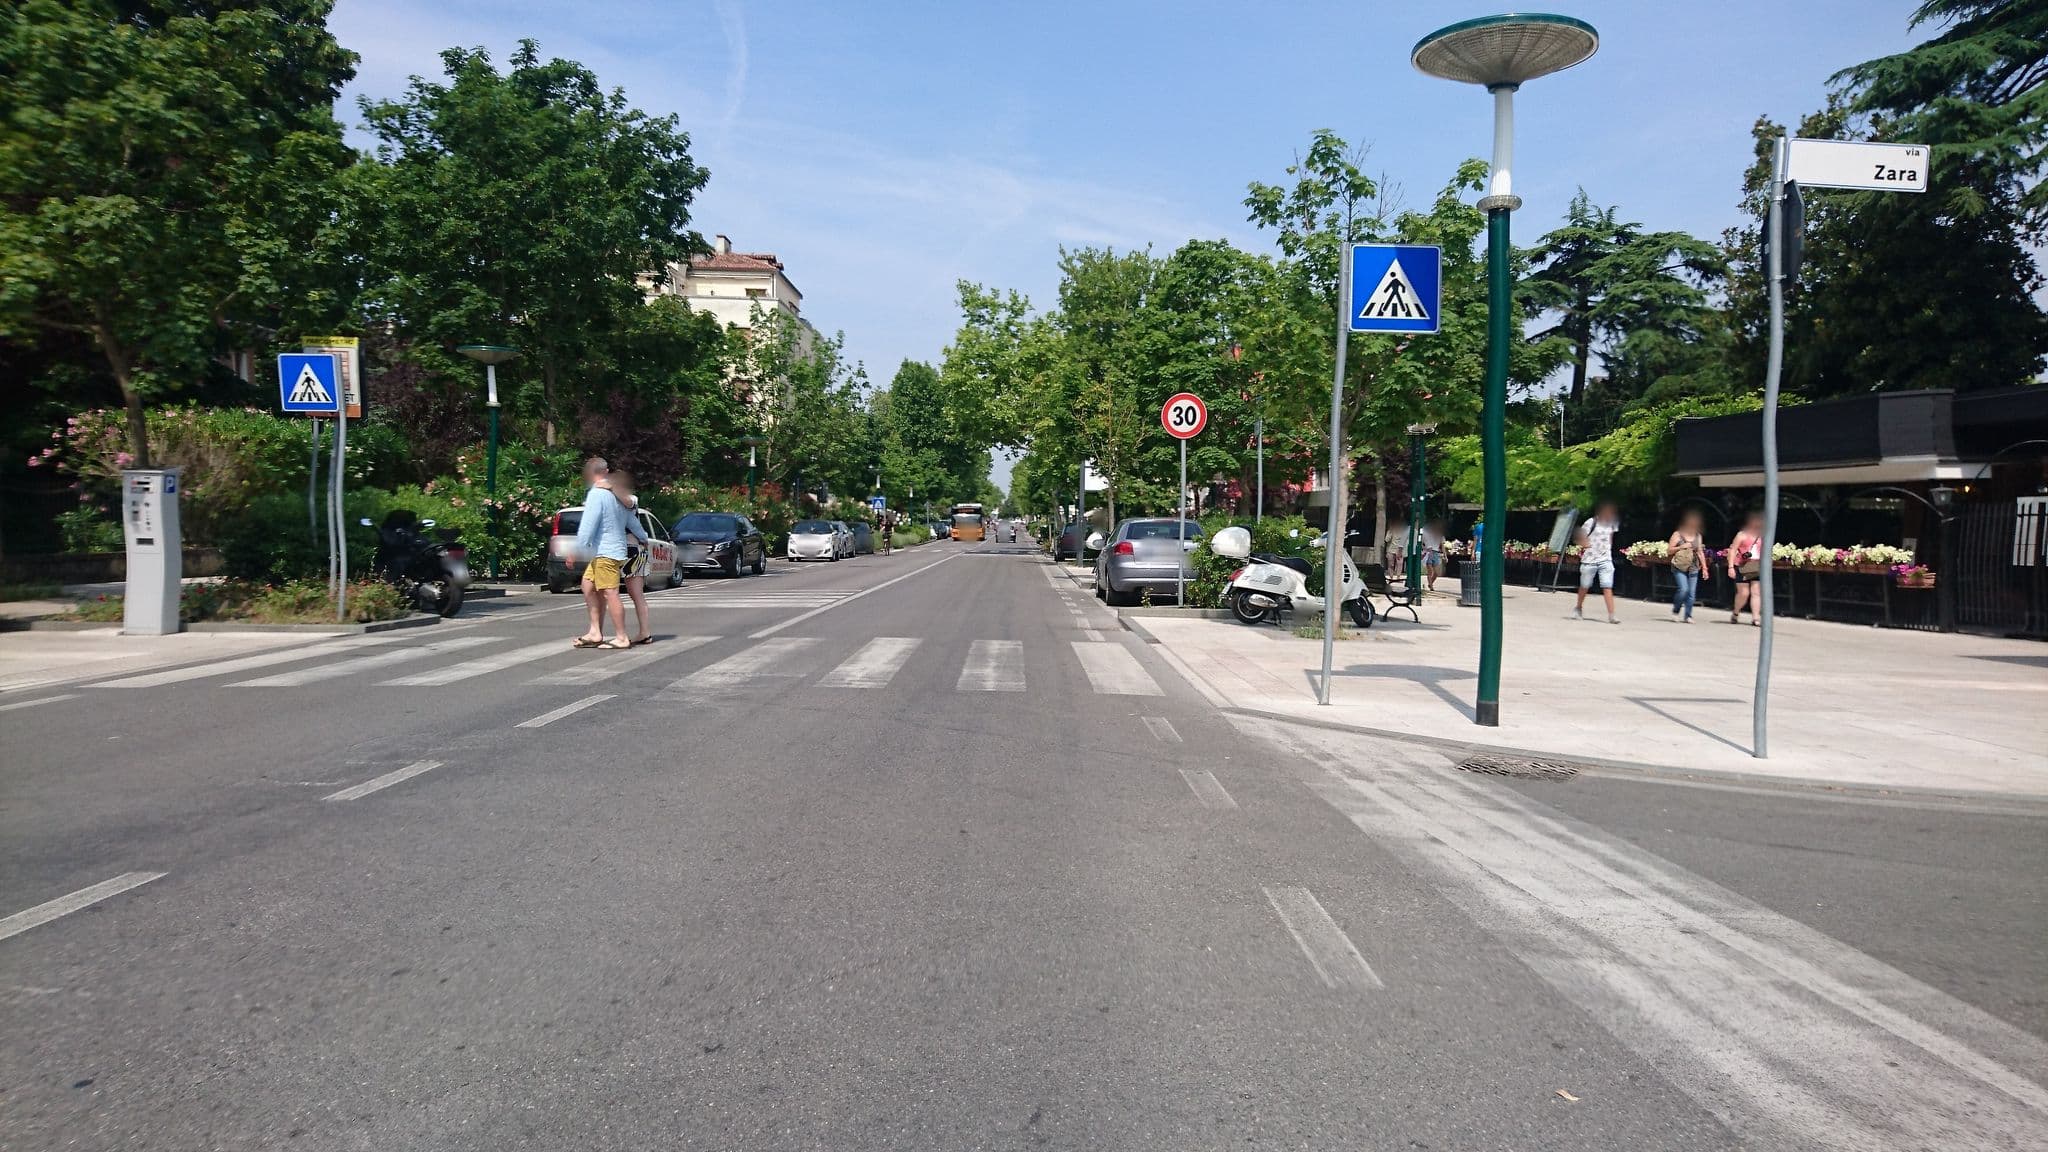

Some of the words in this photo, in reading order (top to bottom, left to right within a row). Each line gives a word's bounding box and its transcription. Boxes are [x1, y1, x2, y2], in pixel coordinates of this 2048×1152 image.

[1906, 148, 1920, 157] via
[1874, 164, 1918, 181] Zara
[1173, 406, 1197, 426] 30
